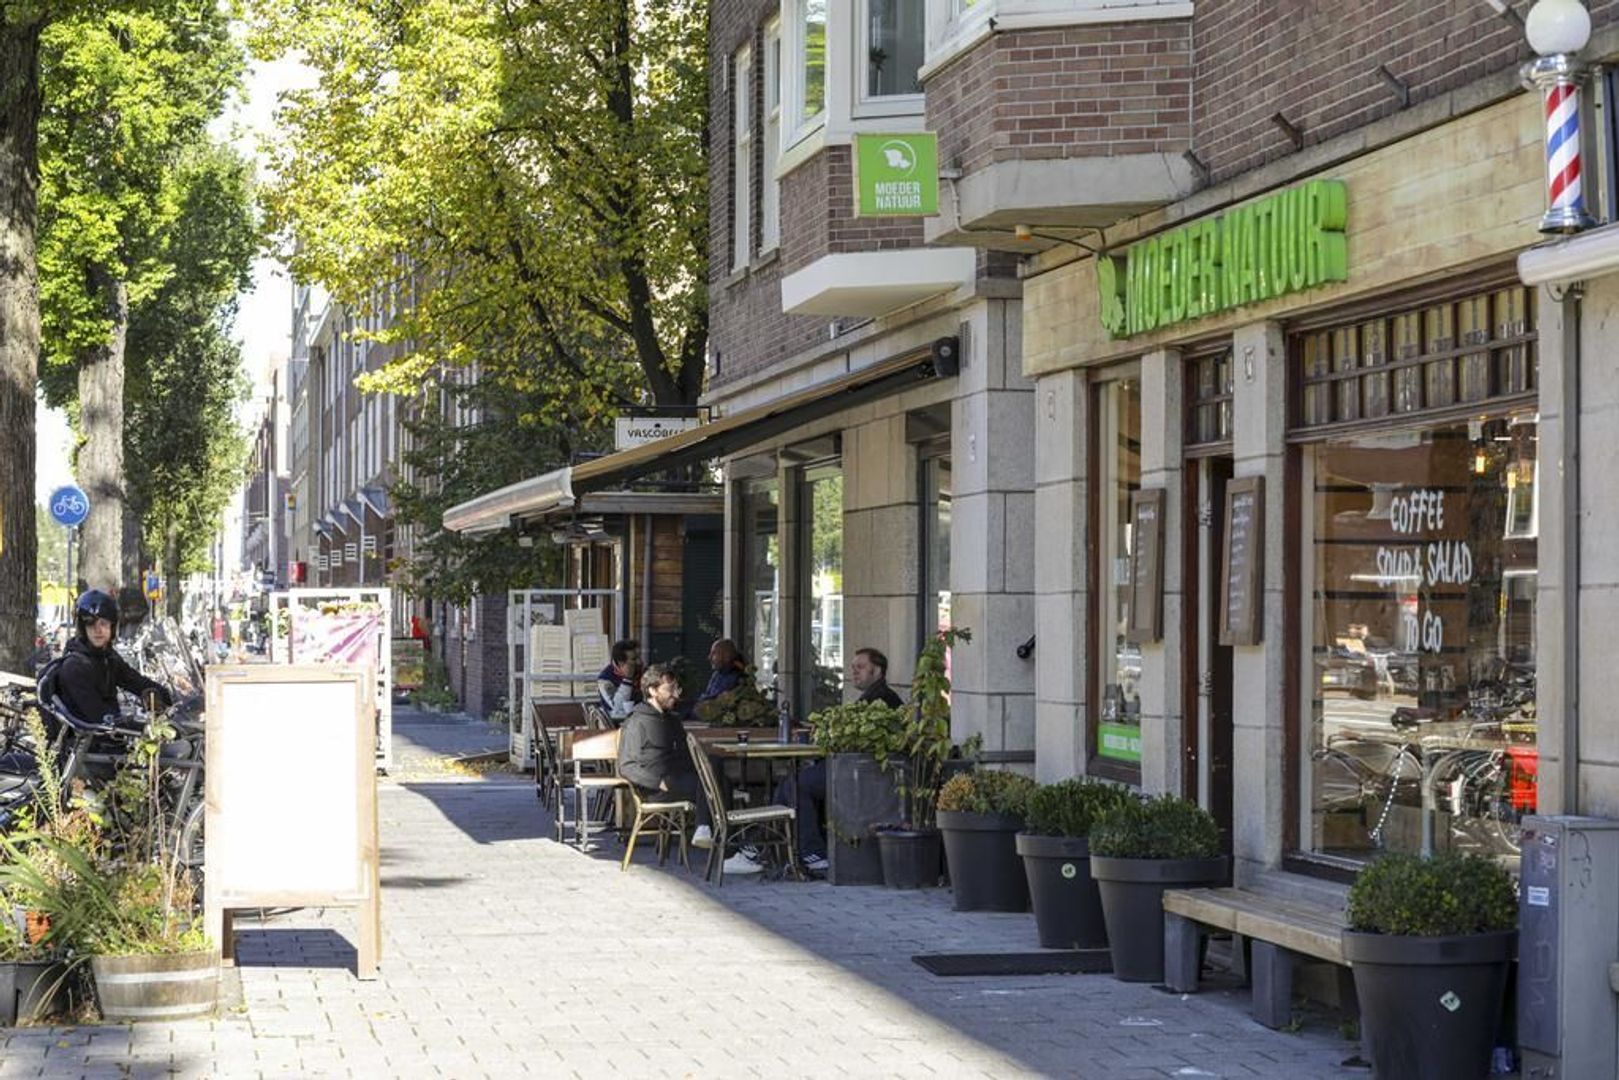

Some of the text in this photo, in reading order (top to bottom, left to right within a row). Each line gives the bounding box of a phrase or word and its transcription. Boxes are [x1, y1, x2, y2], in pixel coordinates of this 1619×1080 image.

[875, 181, 920, 195] MOEDER
[875, 195, 921, 210] NATUUR
[1390, 489, 1444, 534] COFFEE
[1427, 539, 1473, 587] SALAD
[1404, 609, 1443, 653] TO GO
